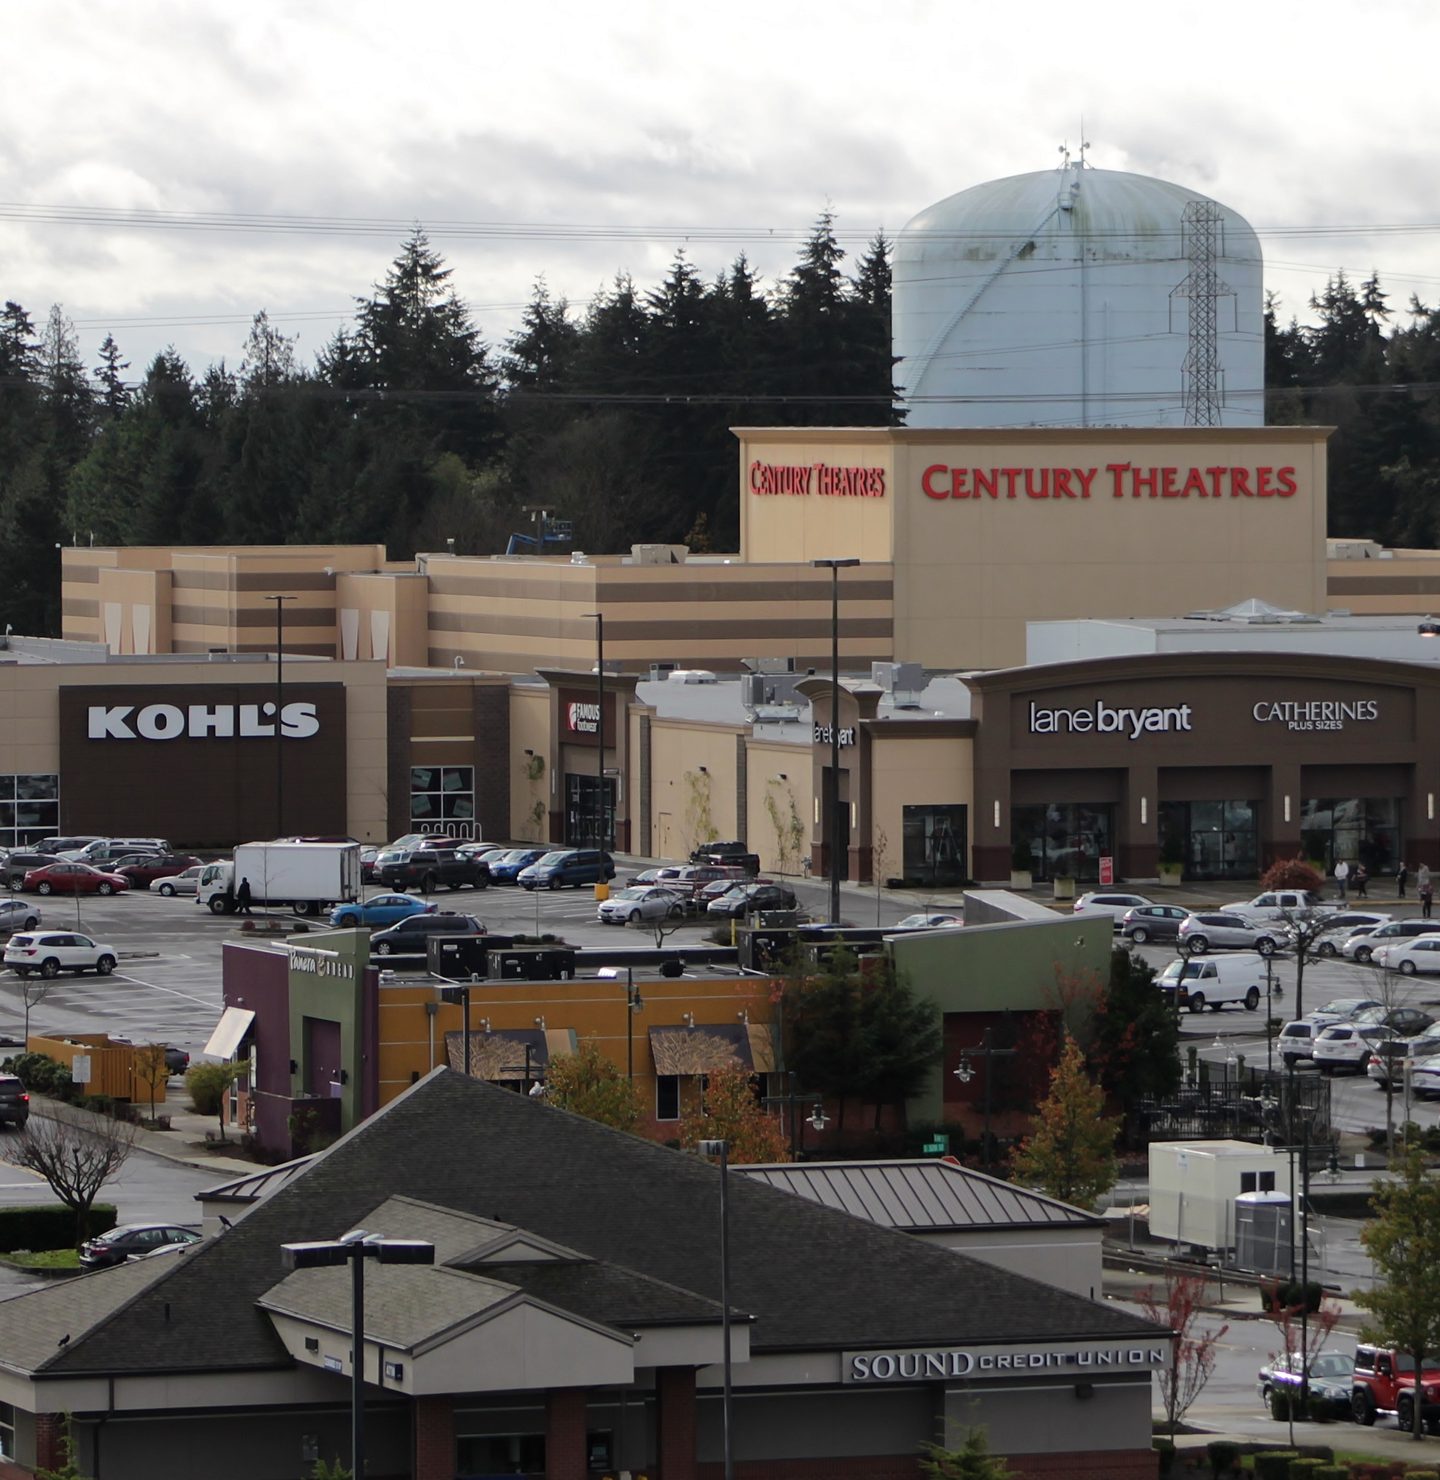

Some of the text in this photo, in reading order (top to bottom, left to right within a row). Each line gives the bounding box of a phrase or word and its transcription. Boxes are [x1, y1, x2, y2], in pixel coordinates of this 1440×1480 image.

[750, 460, 886, 498] CENTURY THEATRES
[921, 462, 1298, 500] CENTURY THEATRES
[88, 702, 320, 740] KOHL'S
[576, 703, 600, 720] FAMOUS
[1253, 701, 1378, 722] CATHERINES
[1288, 720, 1343, 731] PLUS SIZES
[289, 949, 316, 973] Panera
[853, 1350, 1165, 1380] SOUND CREDIT UNION
